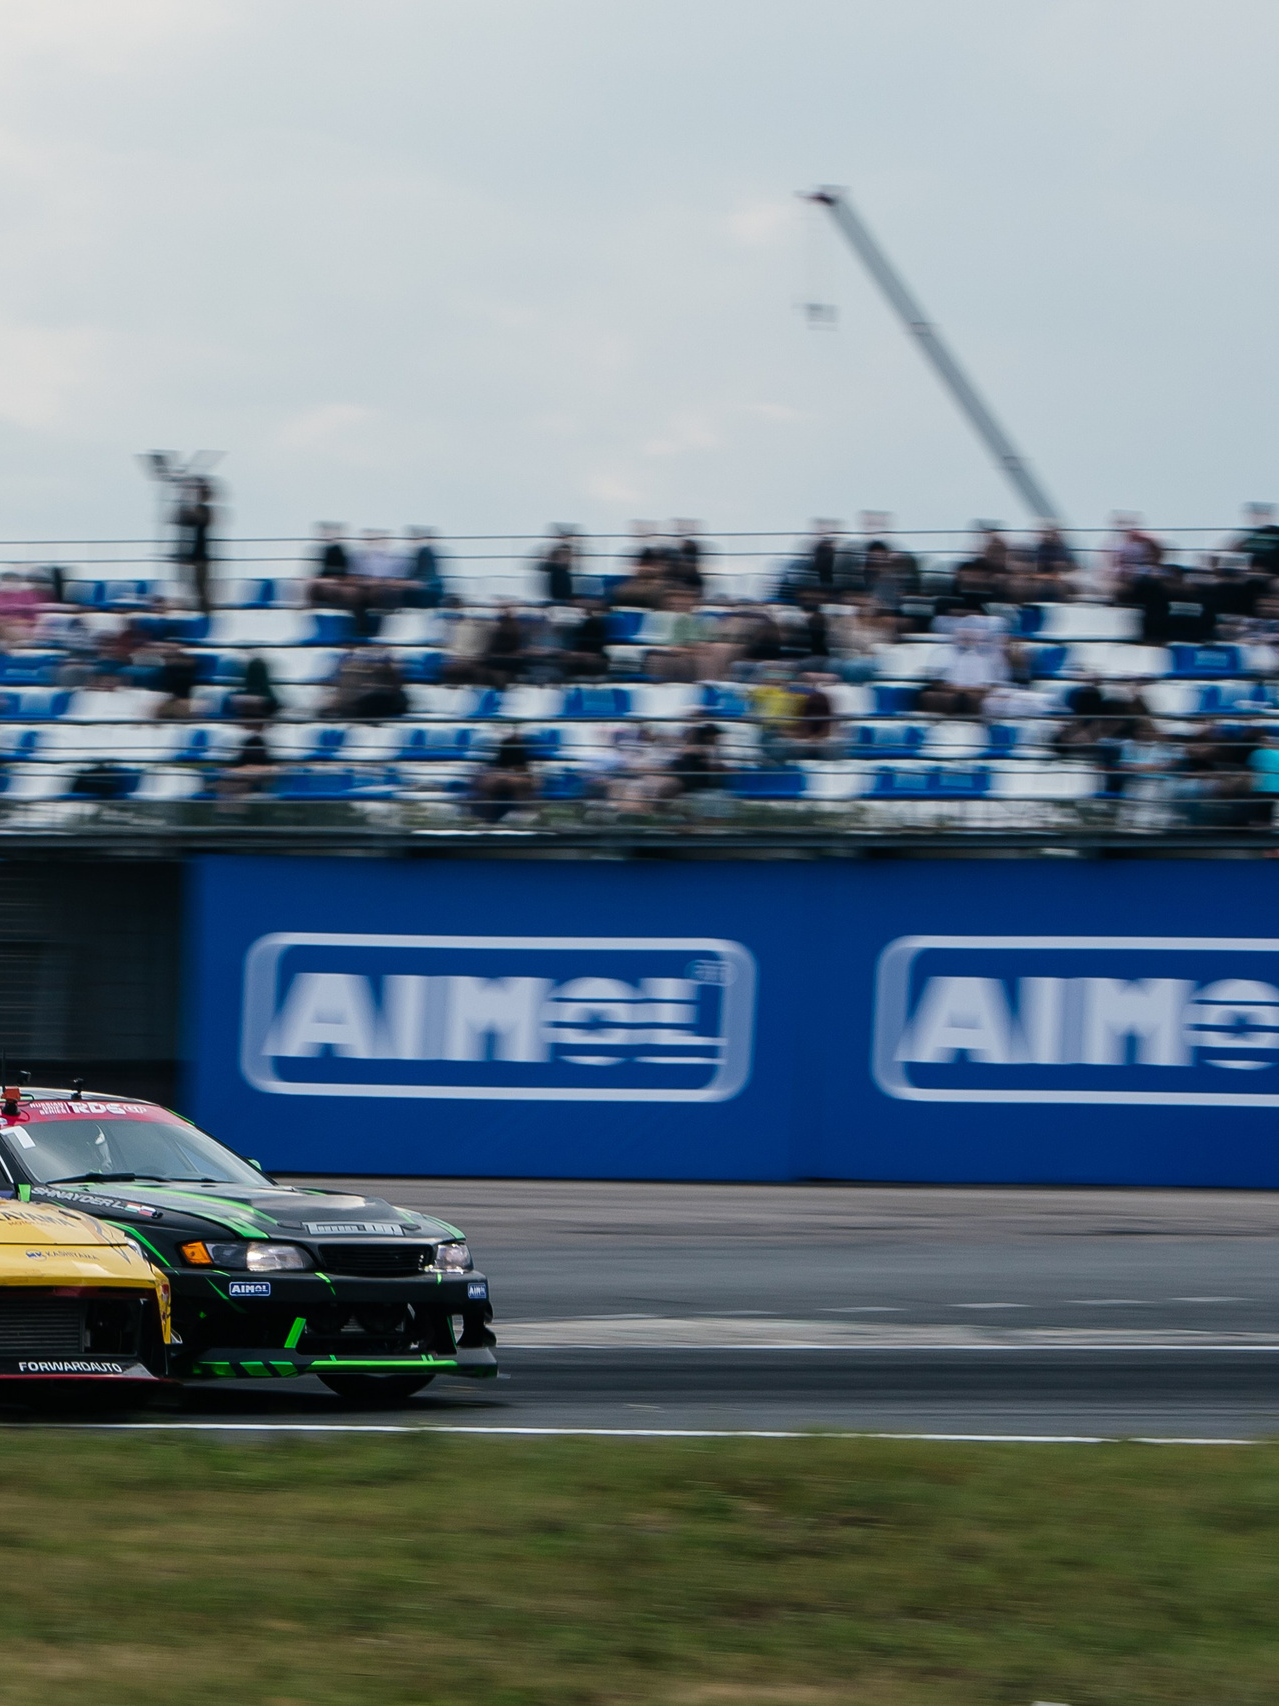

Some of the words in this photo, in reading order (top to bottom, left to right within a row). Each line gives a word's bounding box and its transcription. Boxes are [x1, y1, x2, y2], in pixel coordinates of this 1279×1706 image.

[262, 971, 727, 1066] AIMOL
[894, 975, 1279, 1069] AIMO
[67, 1101, 126, 1115] RDS
[0, 1125, 36, 1149] 1
[31, 1186, 110, 1208] SHNAYDER
[231, 1284, 269, 1294] AIMOL
[18, 1361, 123, 1373] FORWARDAUTO
